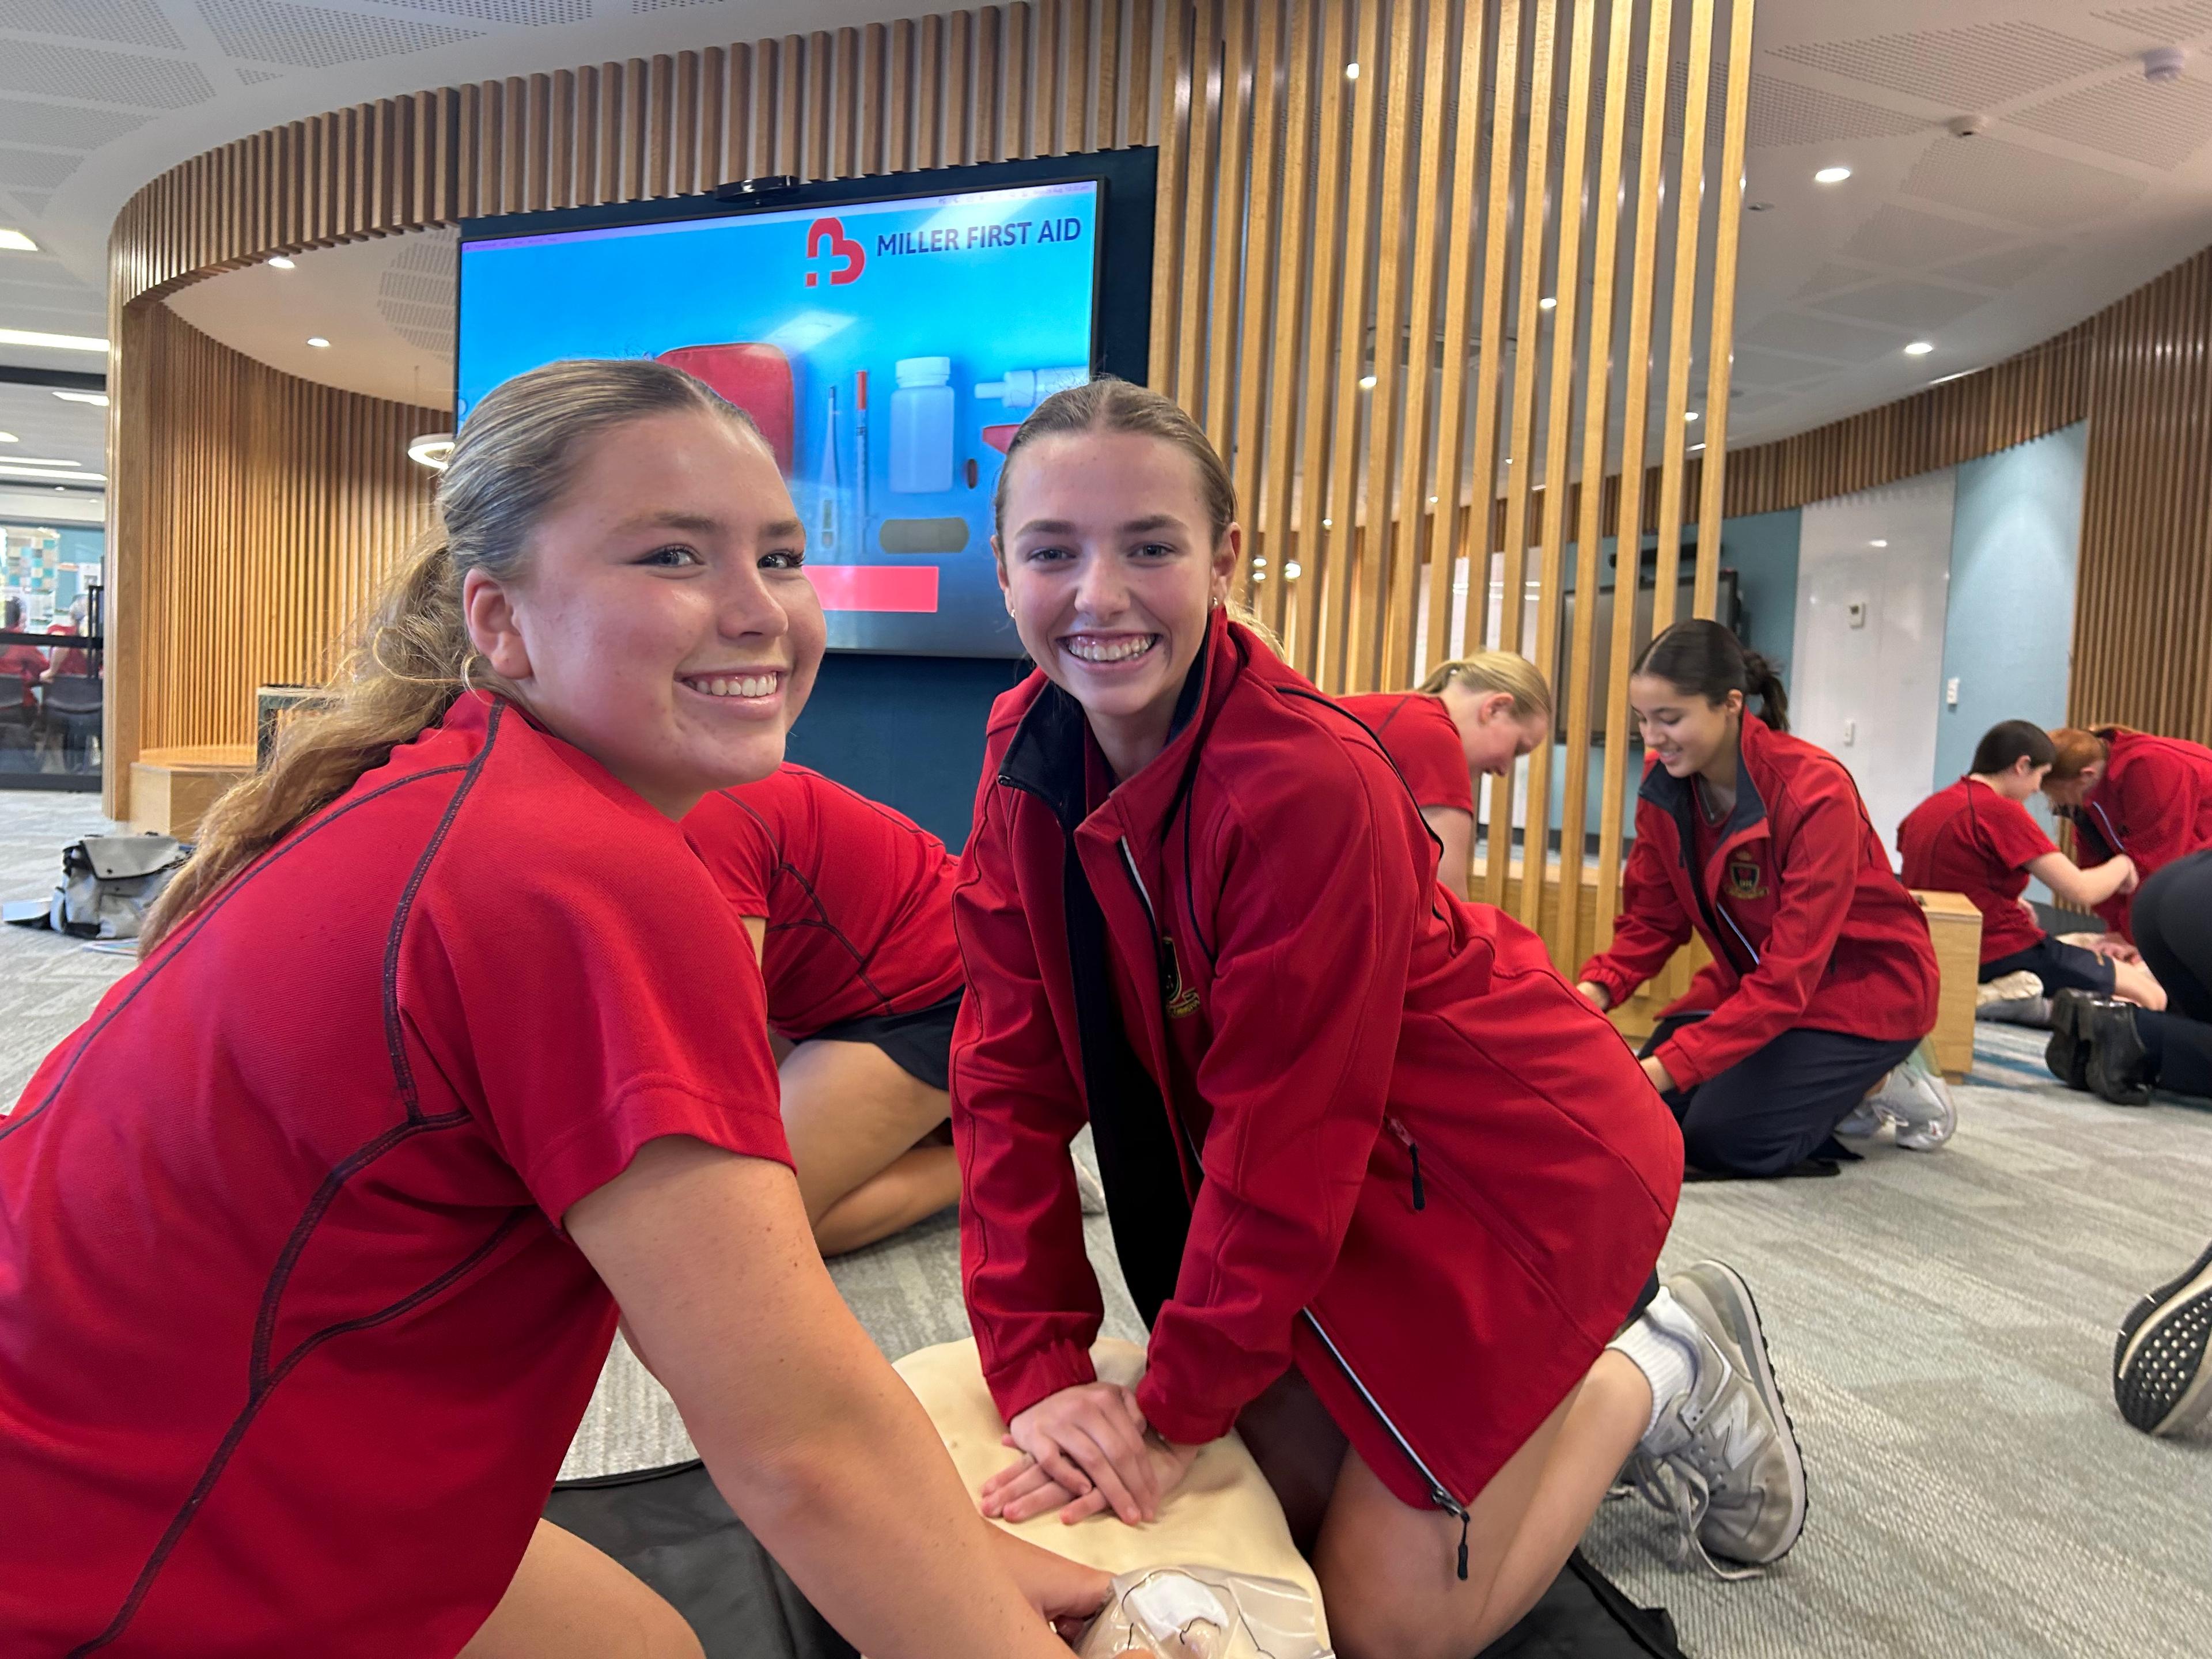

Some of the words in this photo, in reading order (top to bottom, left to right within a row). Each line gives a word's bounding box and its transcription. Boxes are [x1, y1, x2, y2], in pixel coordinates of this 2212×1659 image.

[877, 229, 959, 256] MILLER
[967, 222, 1032, 249] FIRST
[1037, 218, 1081, 243] AID
